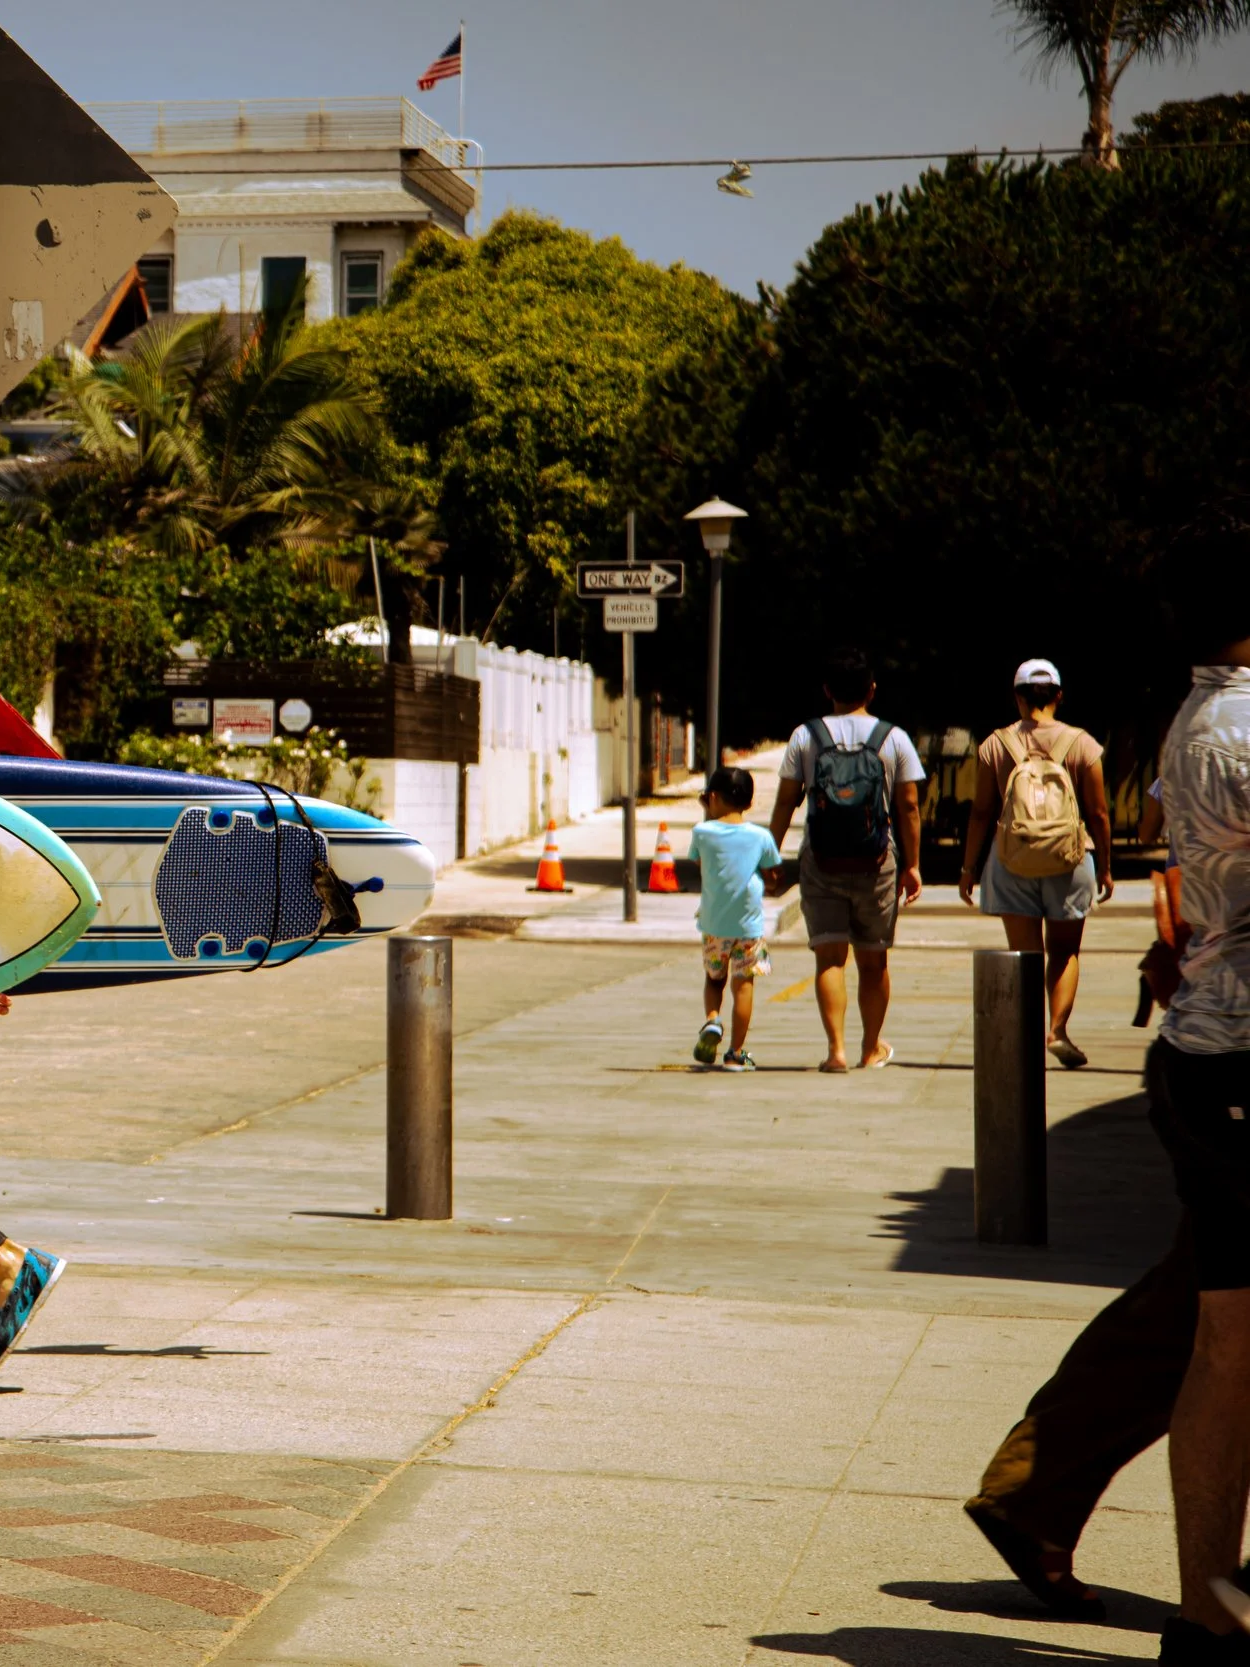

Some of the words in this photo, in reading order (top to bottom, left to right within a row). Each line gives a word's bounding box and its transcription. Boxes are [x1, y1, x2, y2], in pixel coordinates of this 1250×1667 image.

[589, 574, 617, 588] ONE
[622, 573, 650, 588] WAY
[610, 603, 651, 613] VEHICLES
[606, 616, 654, 625] PROHIBITED
